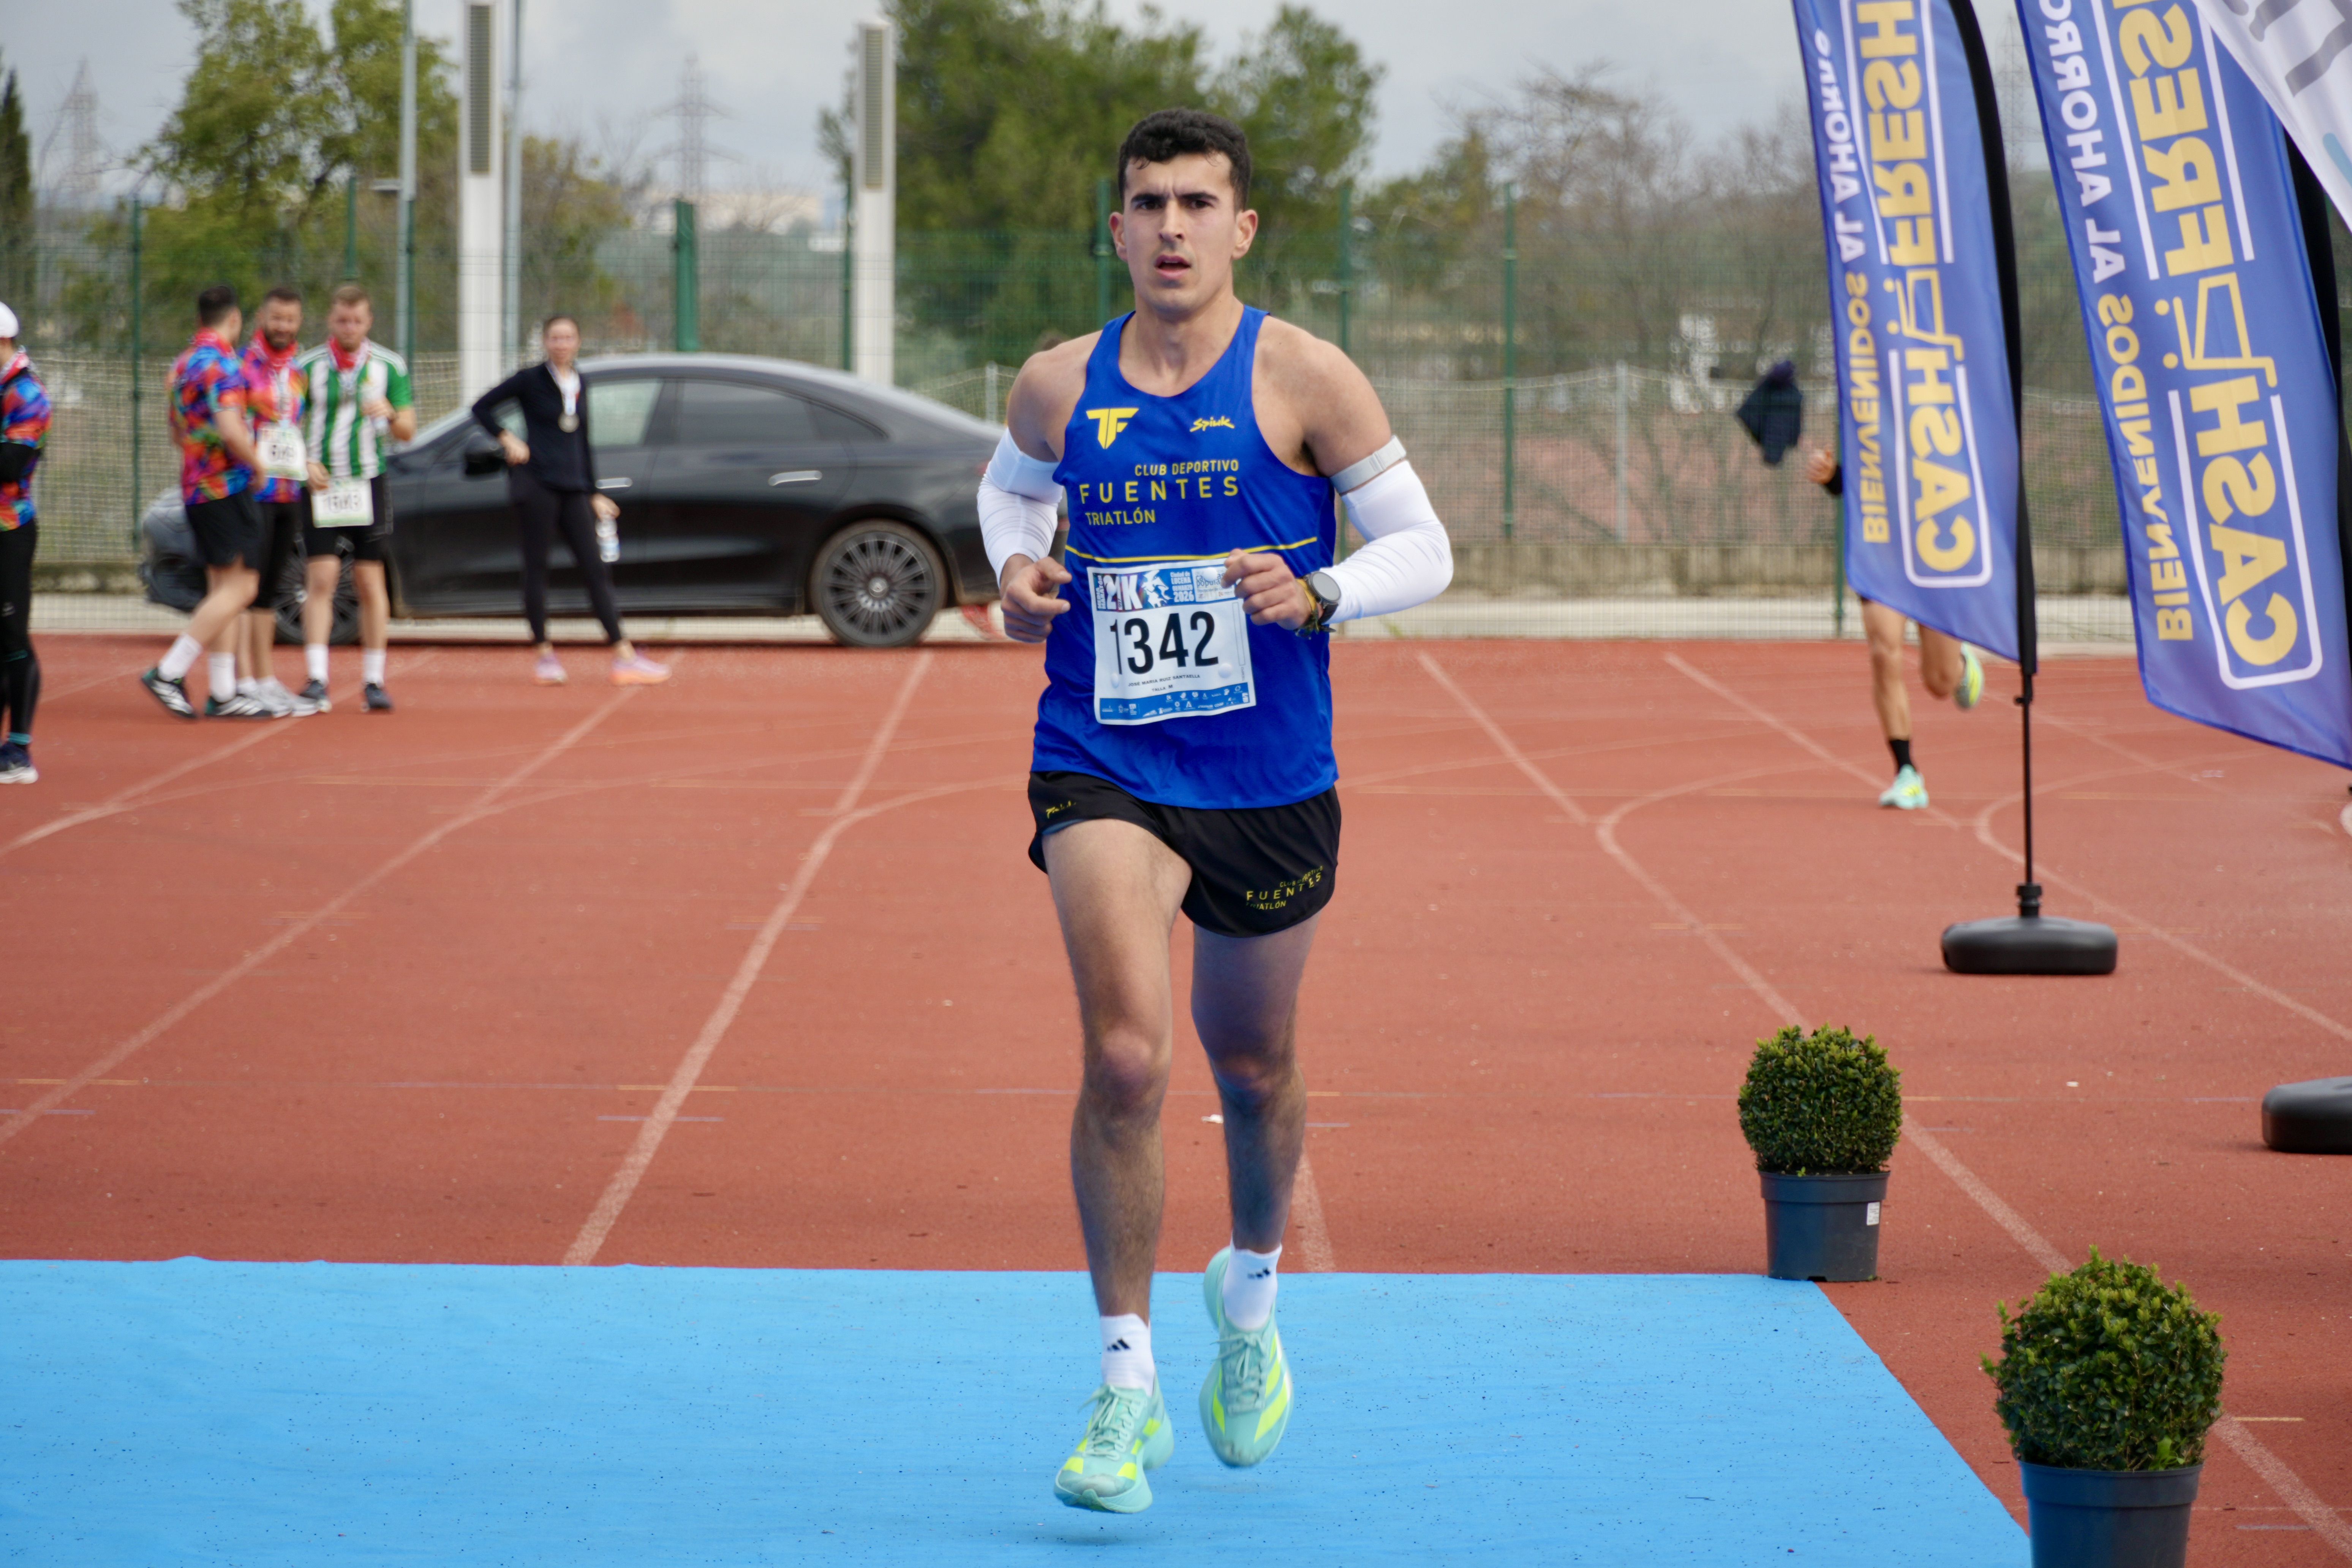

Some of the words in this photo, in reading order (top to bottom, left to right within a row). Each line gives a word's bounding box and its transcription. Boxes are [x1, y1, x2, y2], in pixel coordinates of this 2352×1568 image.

[1135, 465, 1167, 476] CLUB
[1172, 460, 1239, 475] DEPORTIVO
[1079, 476, 1239, 504] FUENTES
[1085, 507, 1156, 525] TRIATLÓN
[1173, 590, 1194, 603] 2026
[1110, 611, 1219, 675] 1342
[1246, 872, 1321, 901] FUENTES
